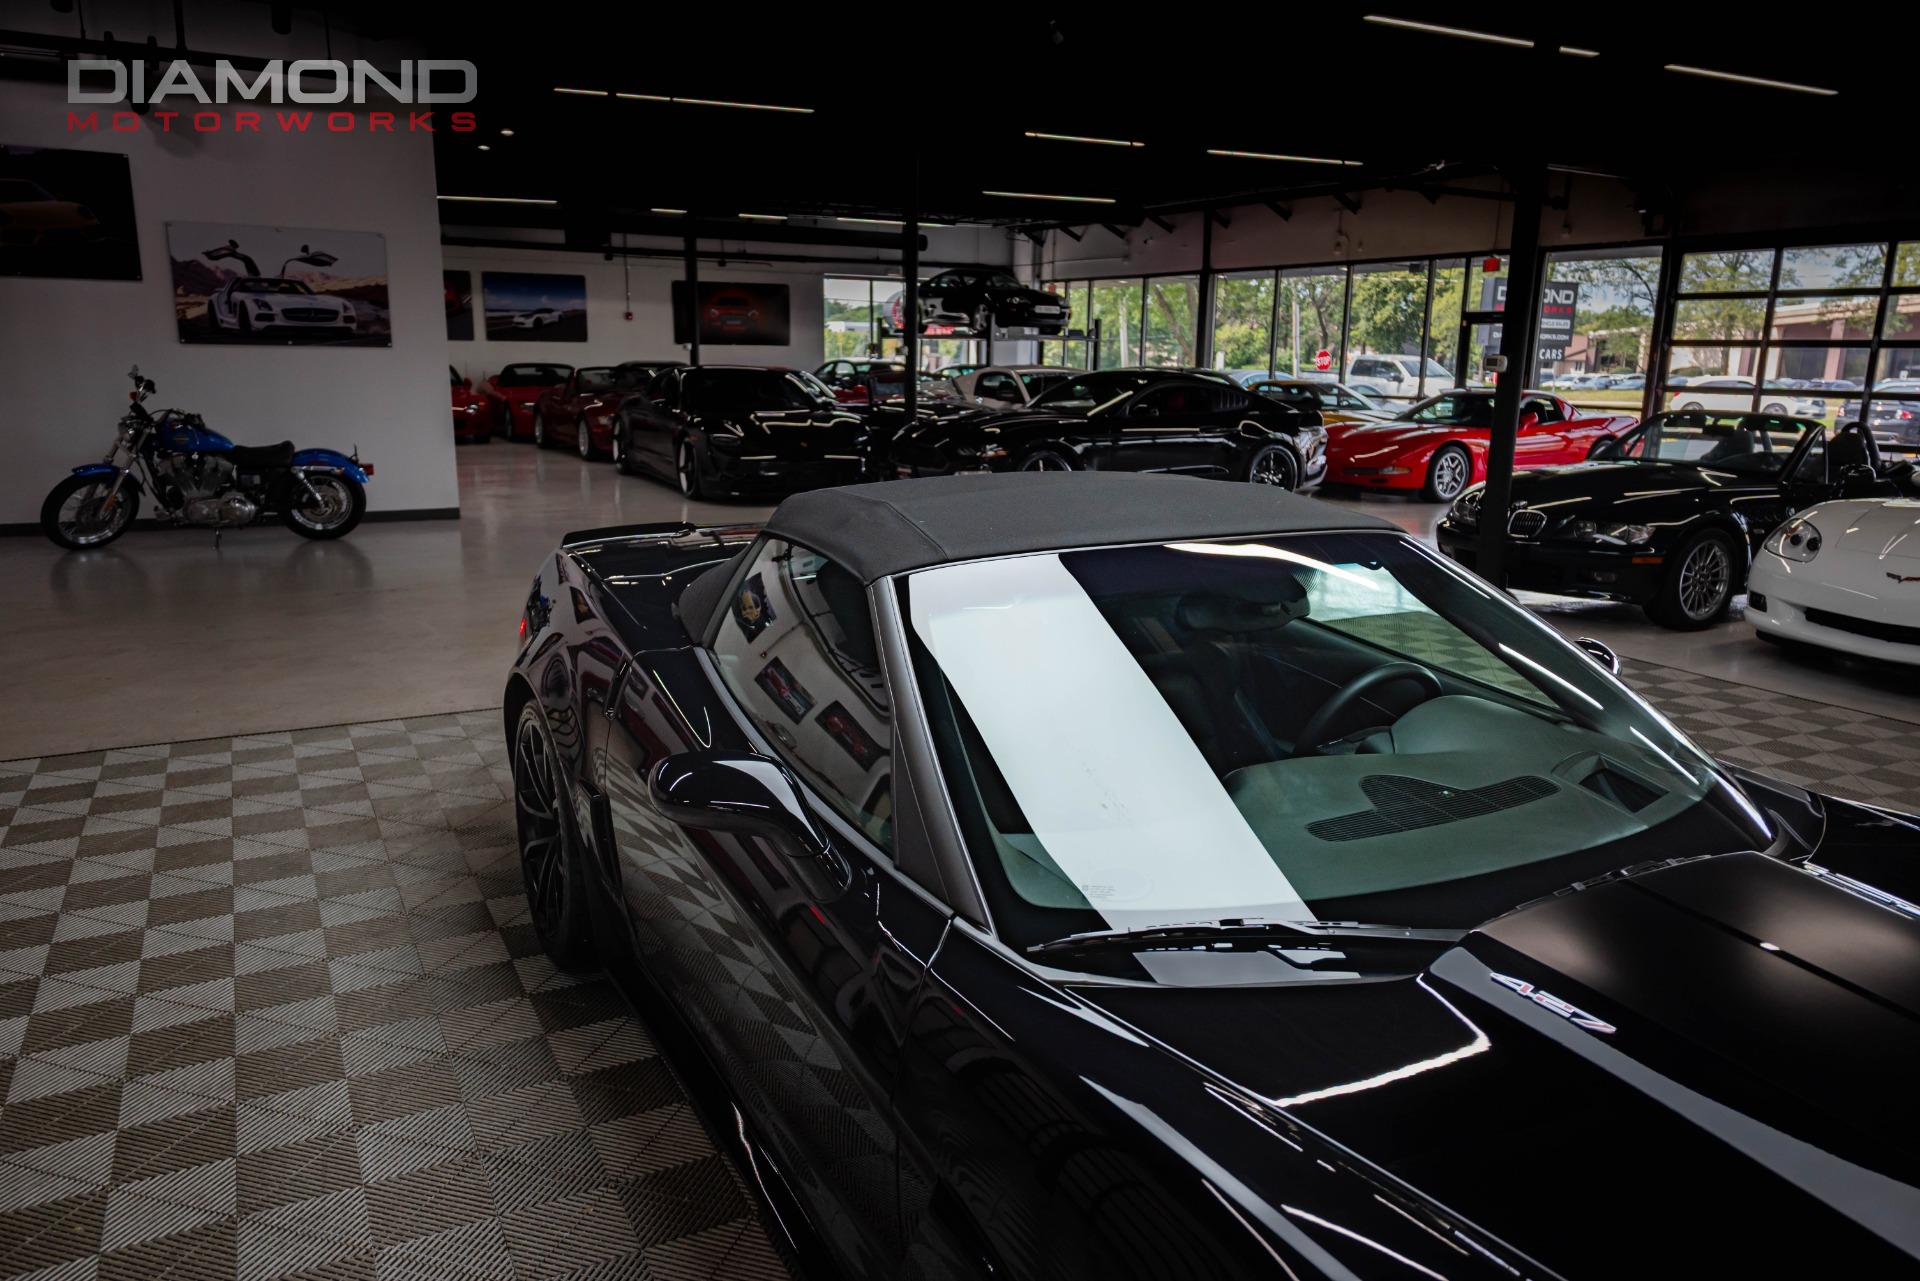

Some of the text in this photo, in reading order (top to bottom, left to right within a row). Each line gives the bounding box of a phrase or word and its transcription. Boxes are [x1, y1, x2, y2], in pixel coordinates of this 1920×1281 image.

[1538, 348, 1563, 360] CARS
[1316, 356, 1331, 367] STOP
[1489, 971, 1618, 1035] 427
